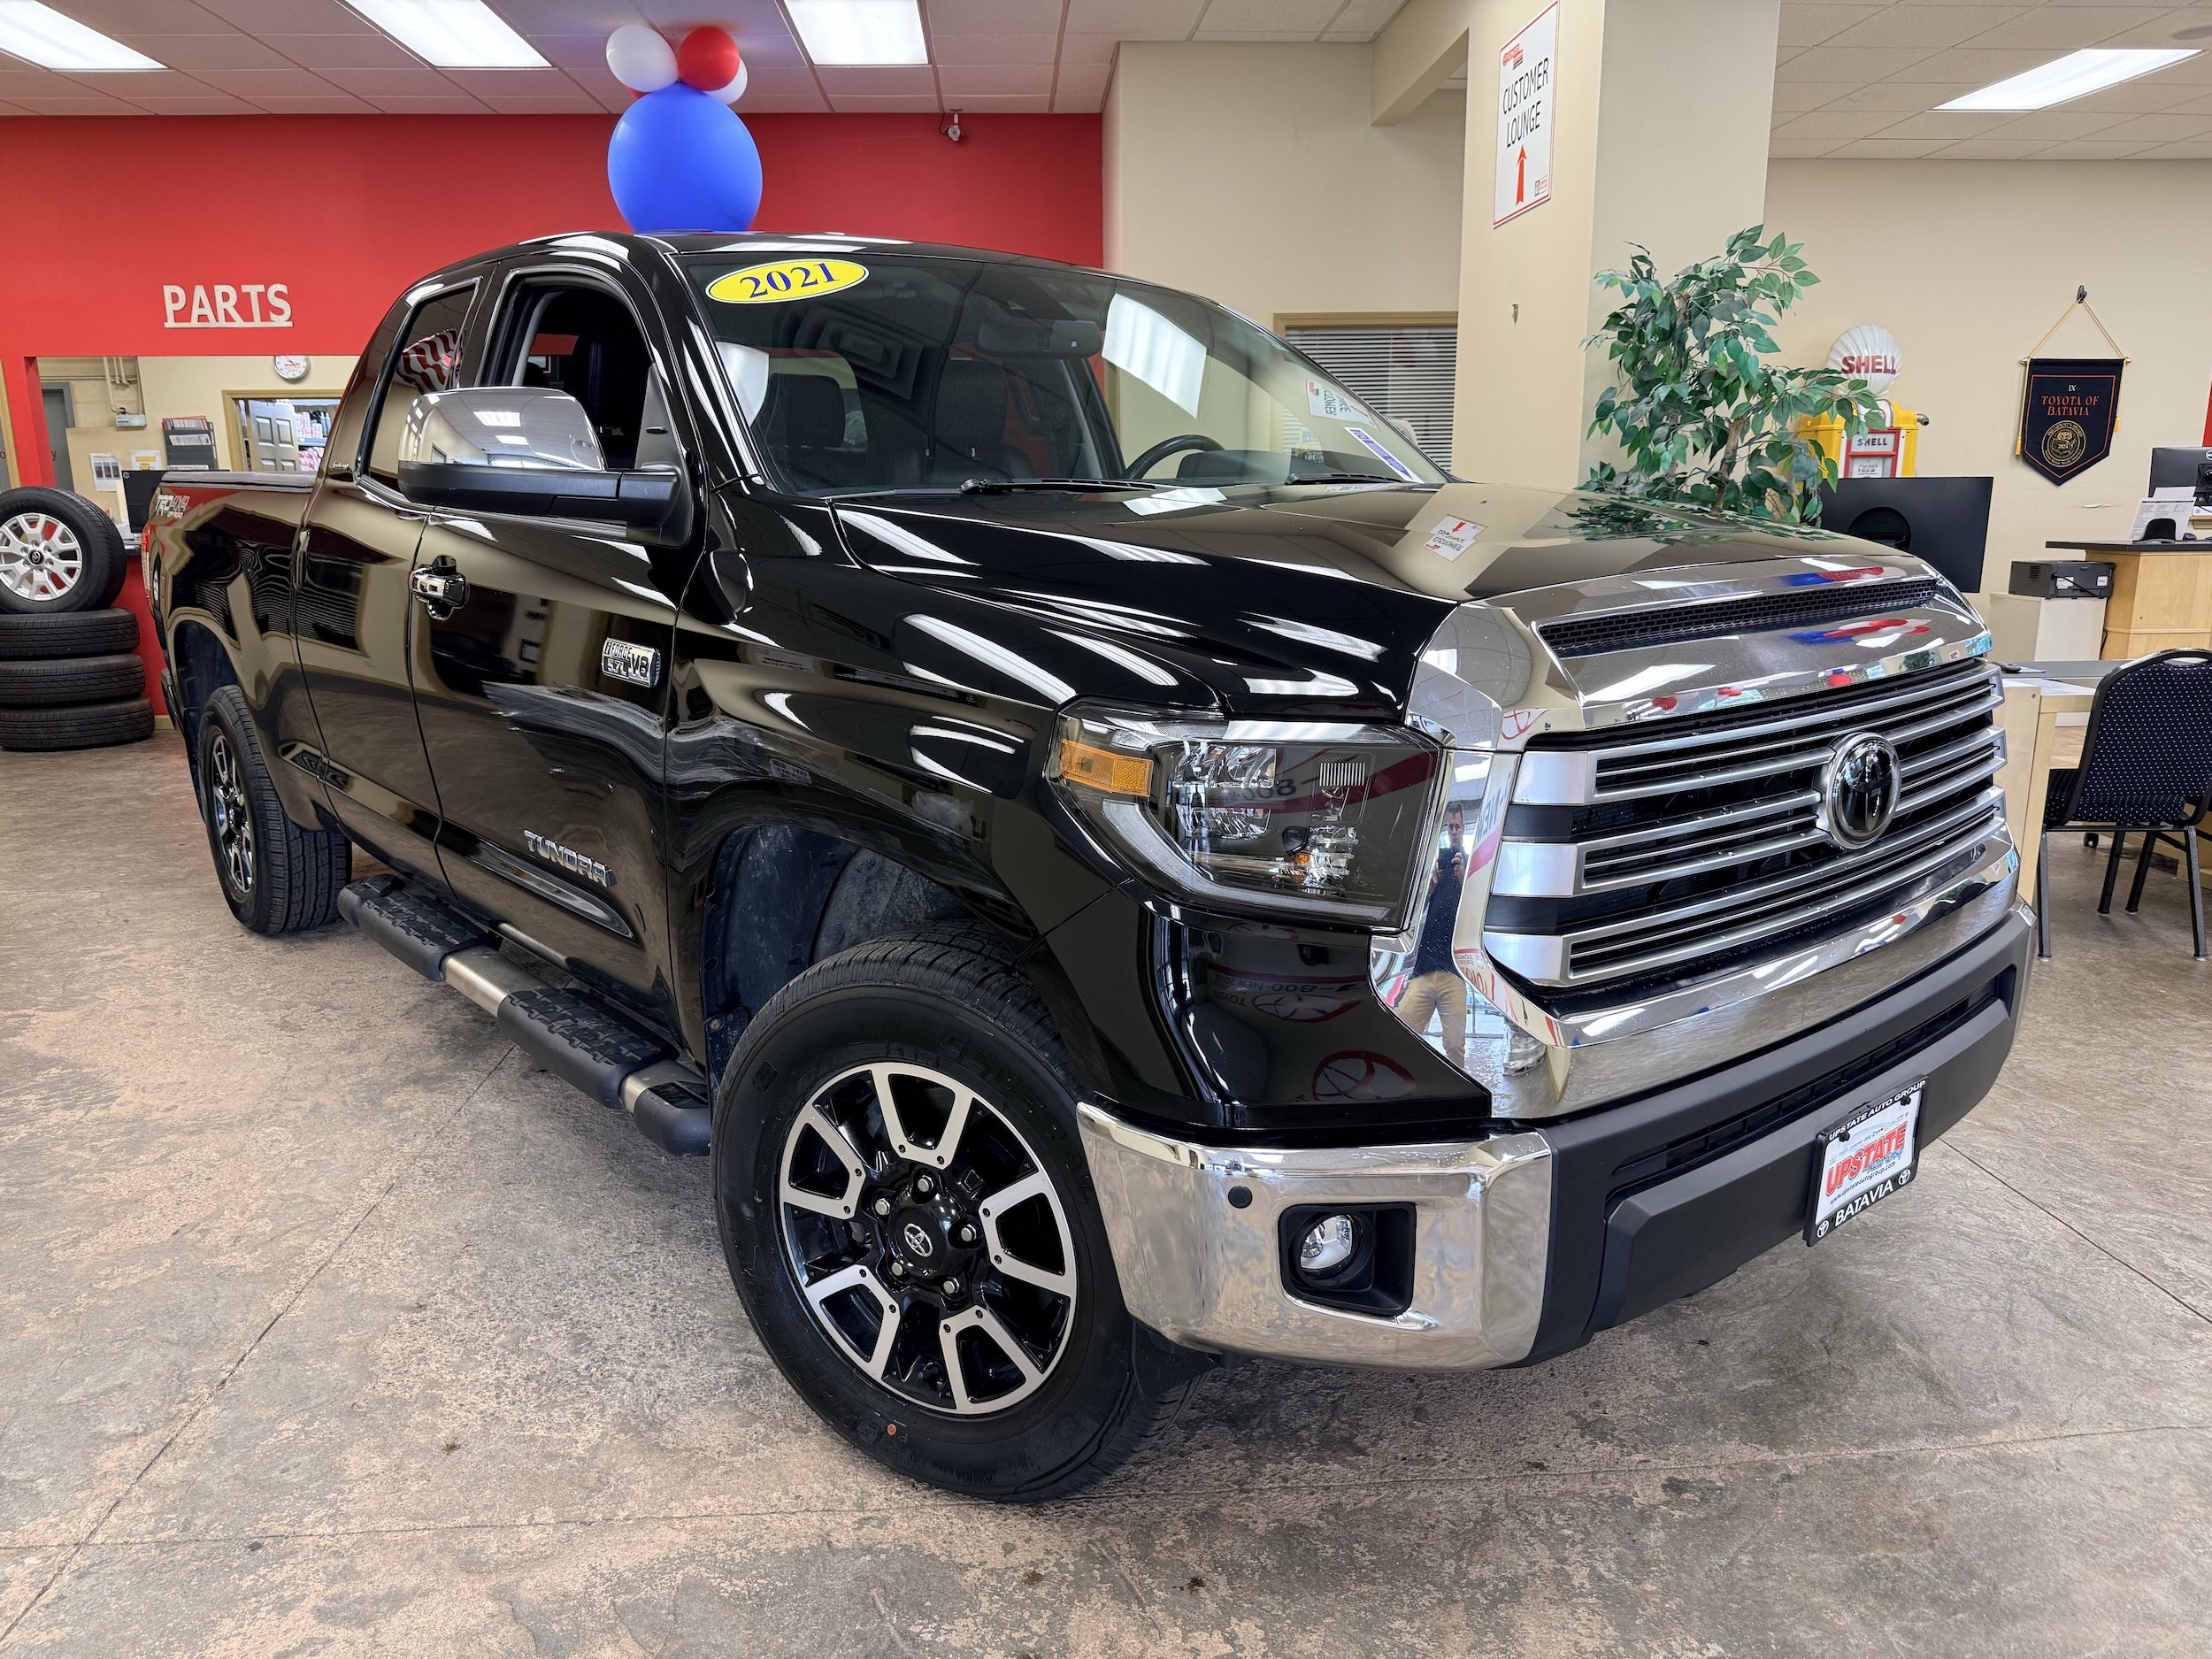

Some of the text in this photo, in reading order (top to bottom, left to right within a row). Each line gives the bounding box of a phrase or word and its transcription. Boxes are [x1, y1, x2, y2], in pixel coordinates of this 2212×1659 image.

[1502, 57, 1548, 114] CUSTOMER
[1506, 100, 1541, 149] LOUNGE
[740, 262, 841, 298] 2021
[163, 284, 293, 323] PARTS
[1840, 355, 1897, 374] SHELL
[2041, 396, 2100, 406] TOYOTA OF
[2047, 406, 2090, 416] BATAVIA
[1857, 437, 1888, 447] SHELL
[524, 829, 615, 887] TUNDRA
[1829, 1112, 1868, 1141] UPSTATE
[1868, 1098, 1893, 1117] AUTO
[1893, 1079, 1926, 1102] GROUP
[1825, 1121, 1908, 1196] UPSTATE
[1834, 1179, 1893, 1227] BATAVIA
